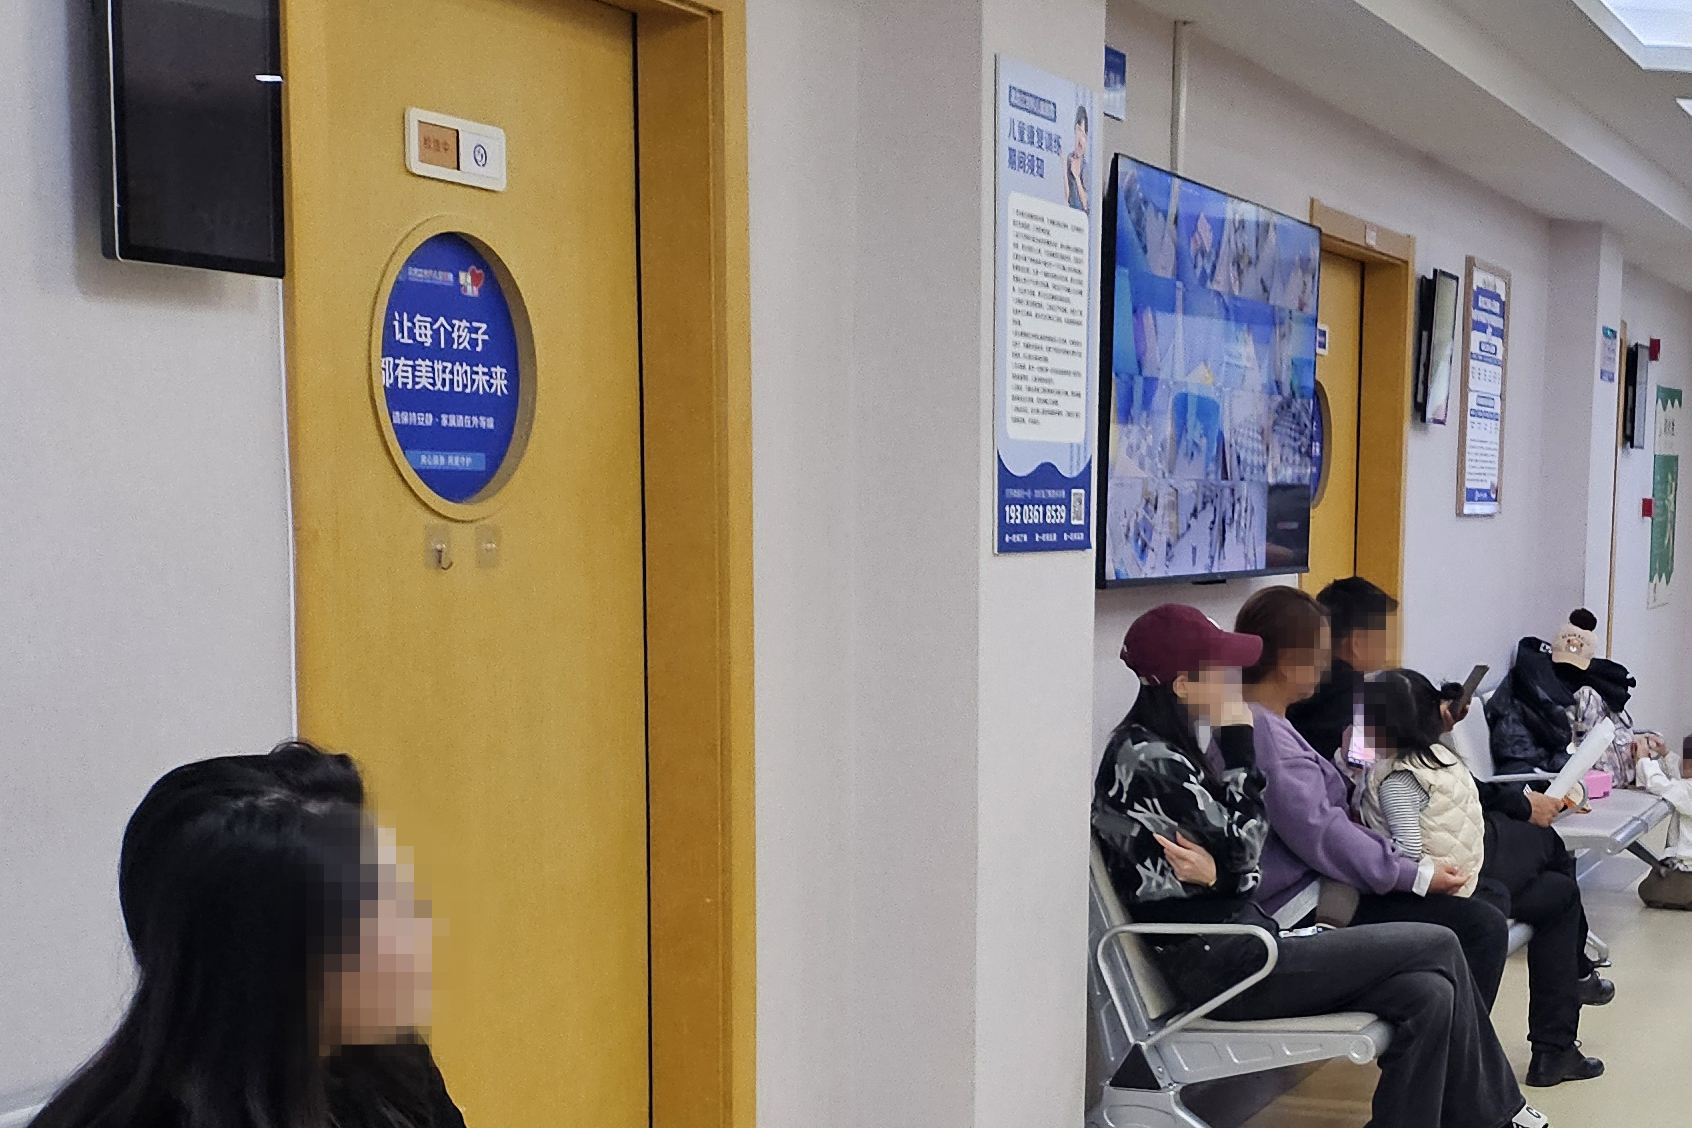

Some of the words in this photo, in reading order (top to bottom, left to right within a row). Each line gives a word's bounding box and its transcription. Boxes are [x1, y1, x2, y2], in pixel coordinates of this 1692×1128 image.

[393, 311, 489, 353] 让每个孩子
